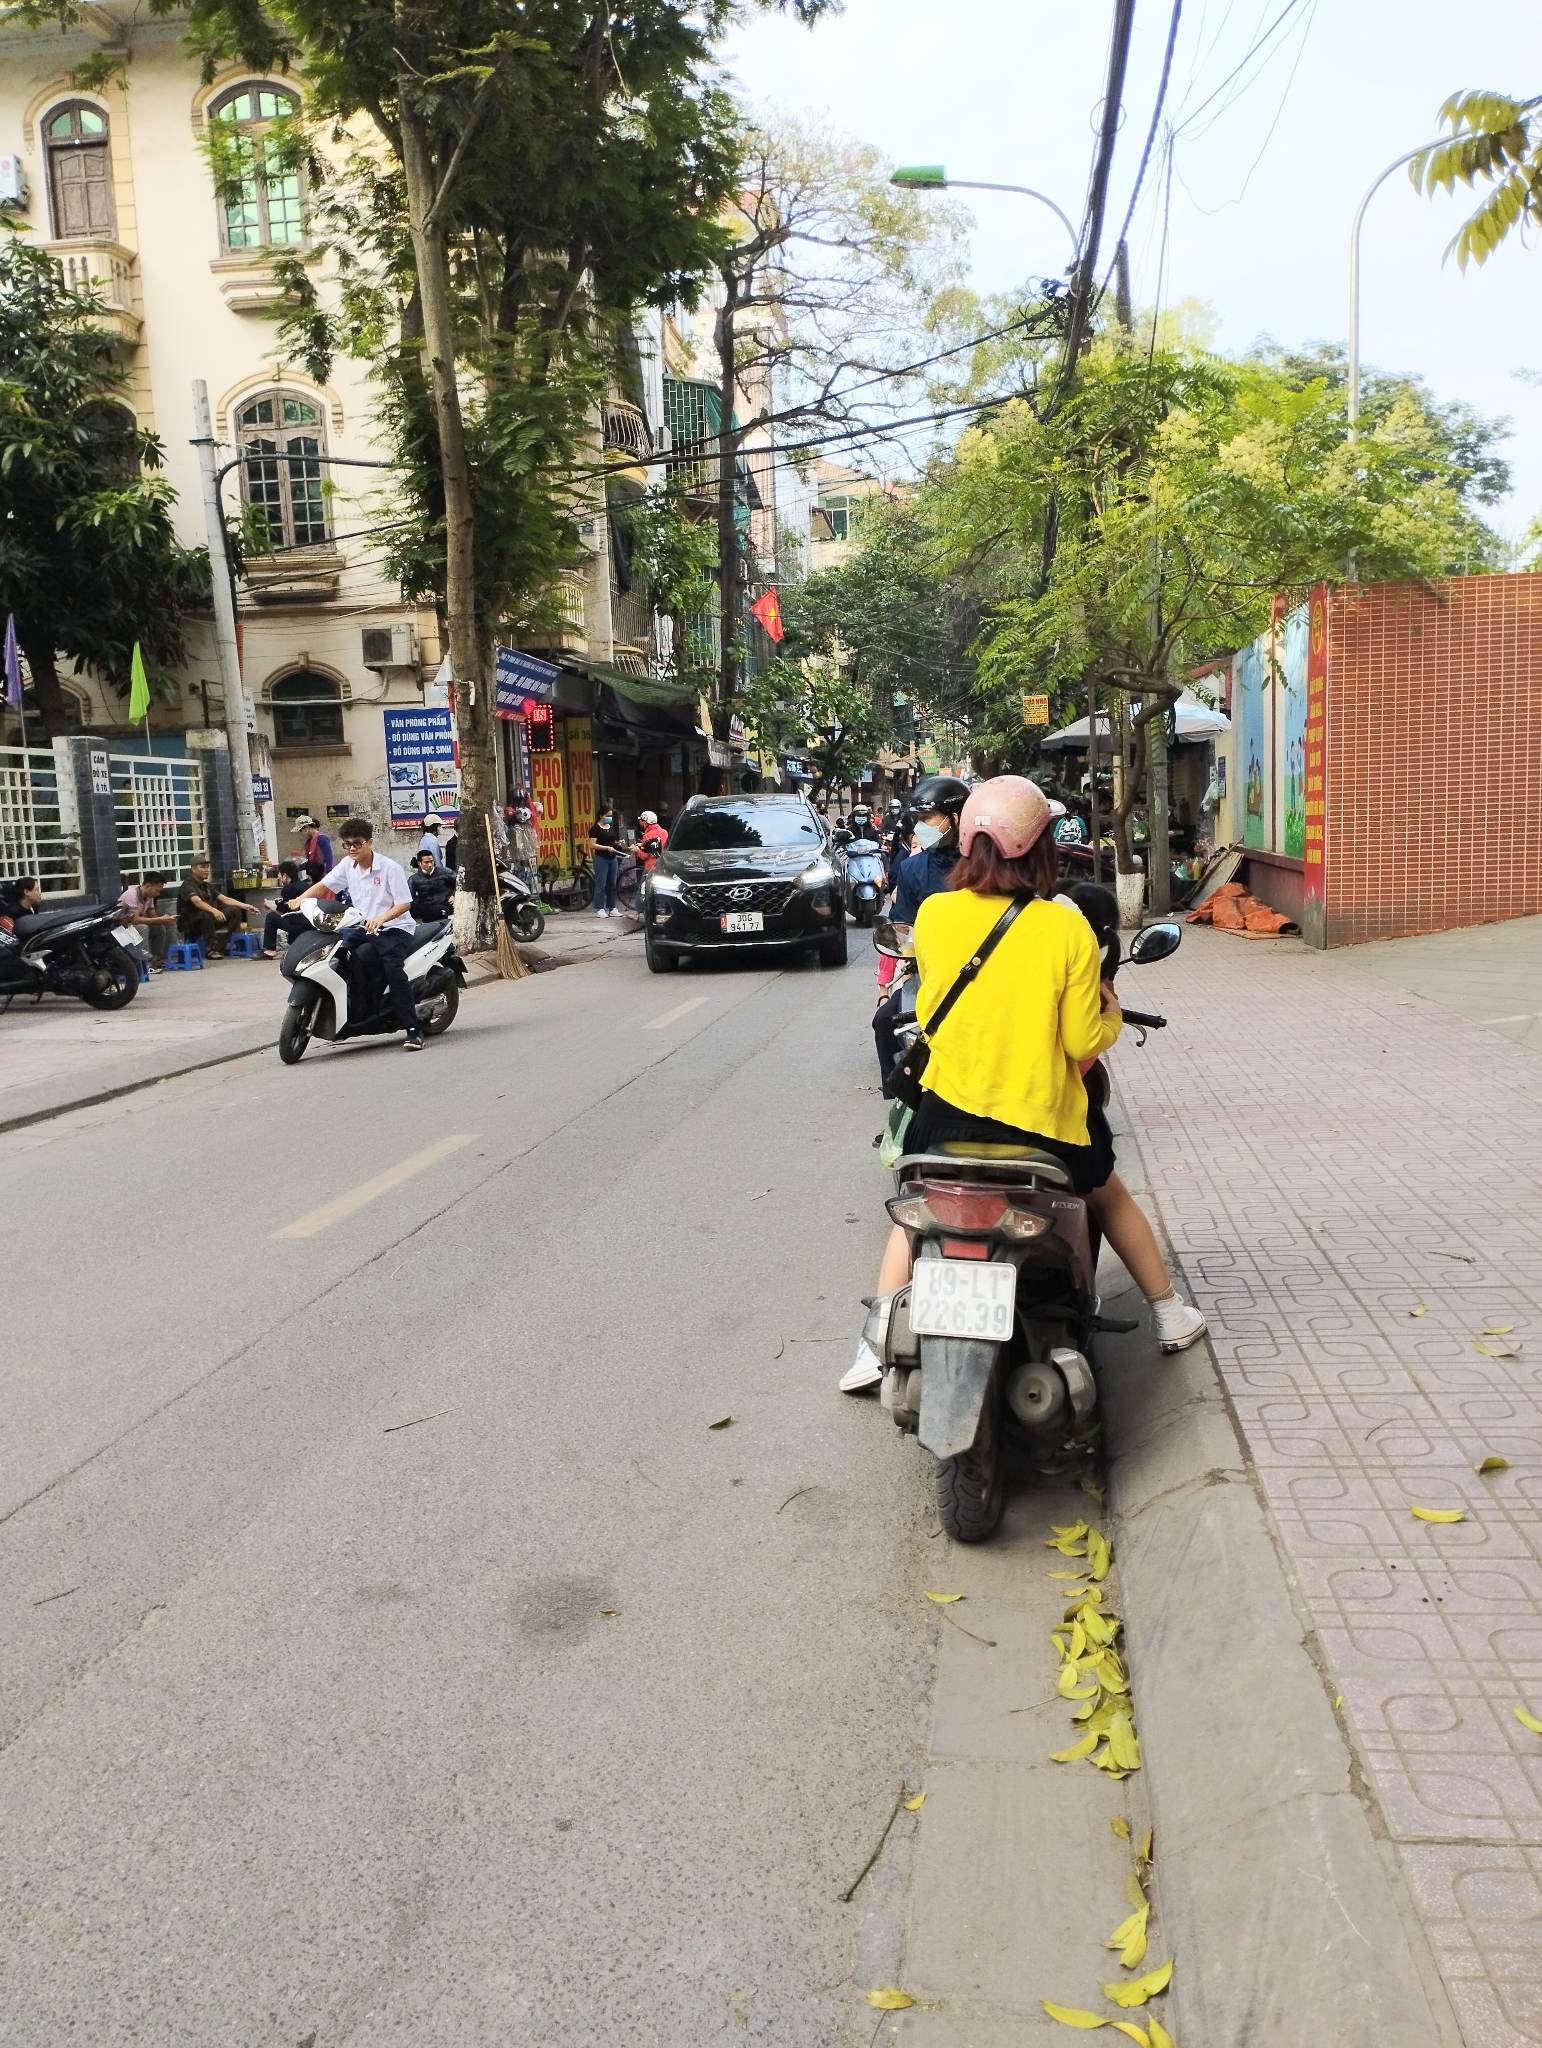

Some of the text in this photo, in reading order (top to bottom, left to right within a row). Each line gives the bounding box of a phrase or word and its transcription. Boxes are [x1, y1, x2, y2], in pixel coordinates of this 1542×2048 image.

[391, 717, 404, 727] VĂN
[405, 717, 427, 727] PHÒNG
[402, 731, 420, 742] DÙNG
[421, 731, 434, 740] VĂN
[435, 729, 452, 740] PHÒN
[403, 745, 420, 756] DÙNG
[436, 745, 452, 754] SINH
[532, 757, 561, 789] PHO
[572, 751, 593, 783] PHO
[537, 790, 558, 821] TO
[575, 783, 592, 815] TO
[1051, 1200, 1080, 1209] VISION
[916, 1299, 1008, 1334] 226.39
